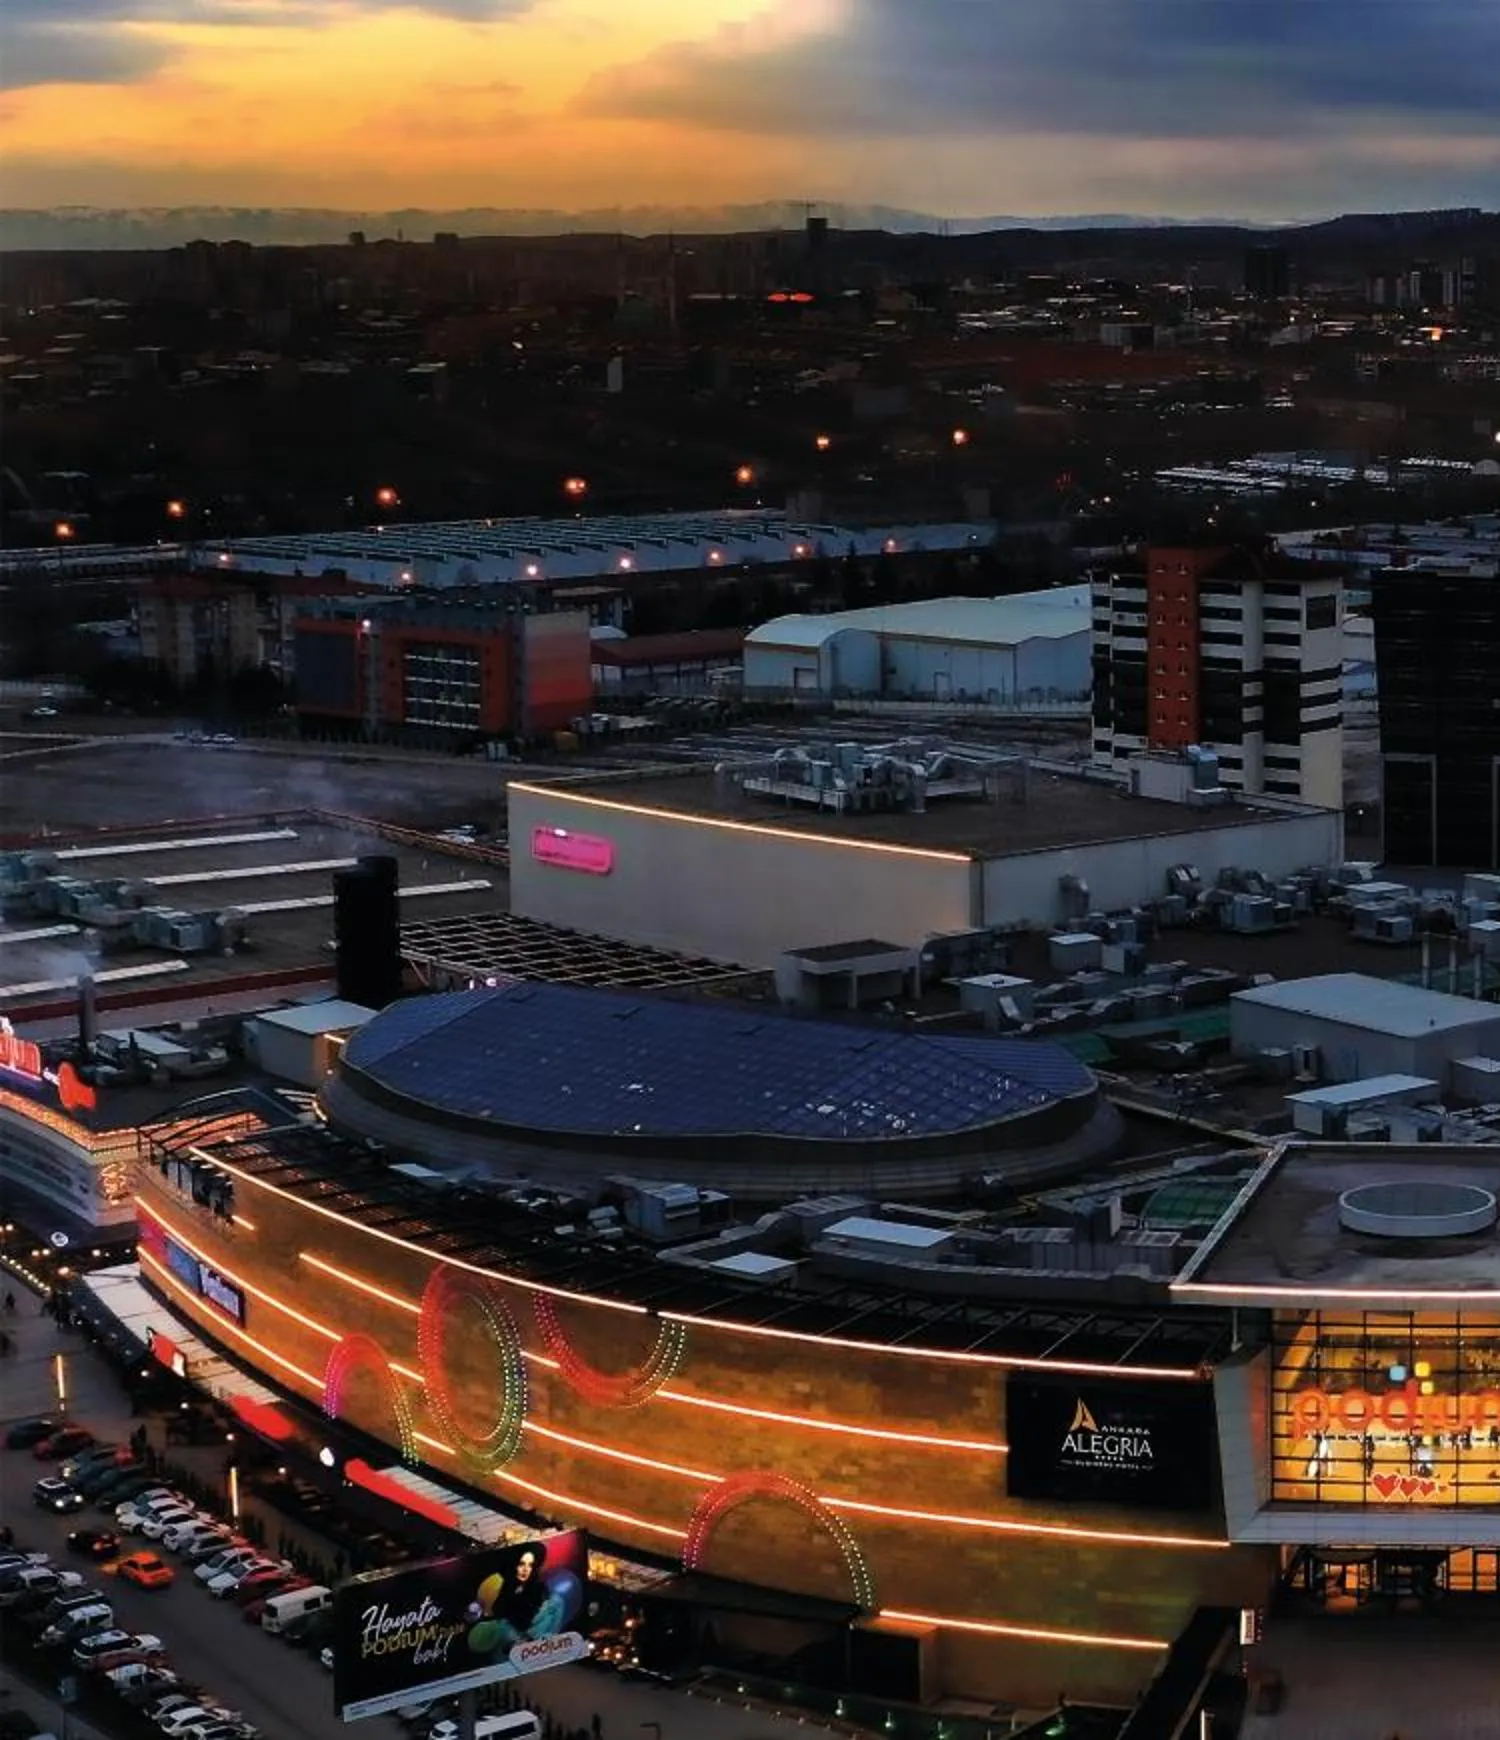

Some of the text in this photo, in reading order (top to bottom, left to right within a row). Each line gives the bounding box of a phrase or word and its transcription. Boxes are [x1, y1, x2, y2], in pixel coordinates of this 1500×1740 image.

[1061, 1432, 1153, 1458] ALEGRIA
[361, 1595, 443, 1641] Hayata
[520, 1635, 574, 1662] podium
